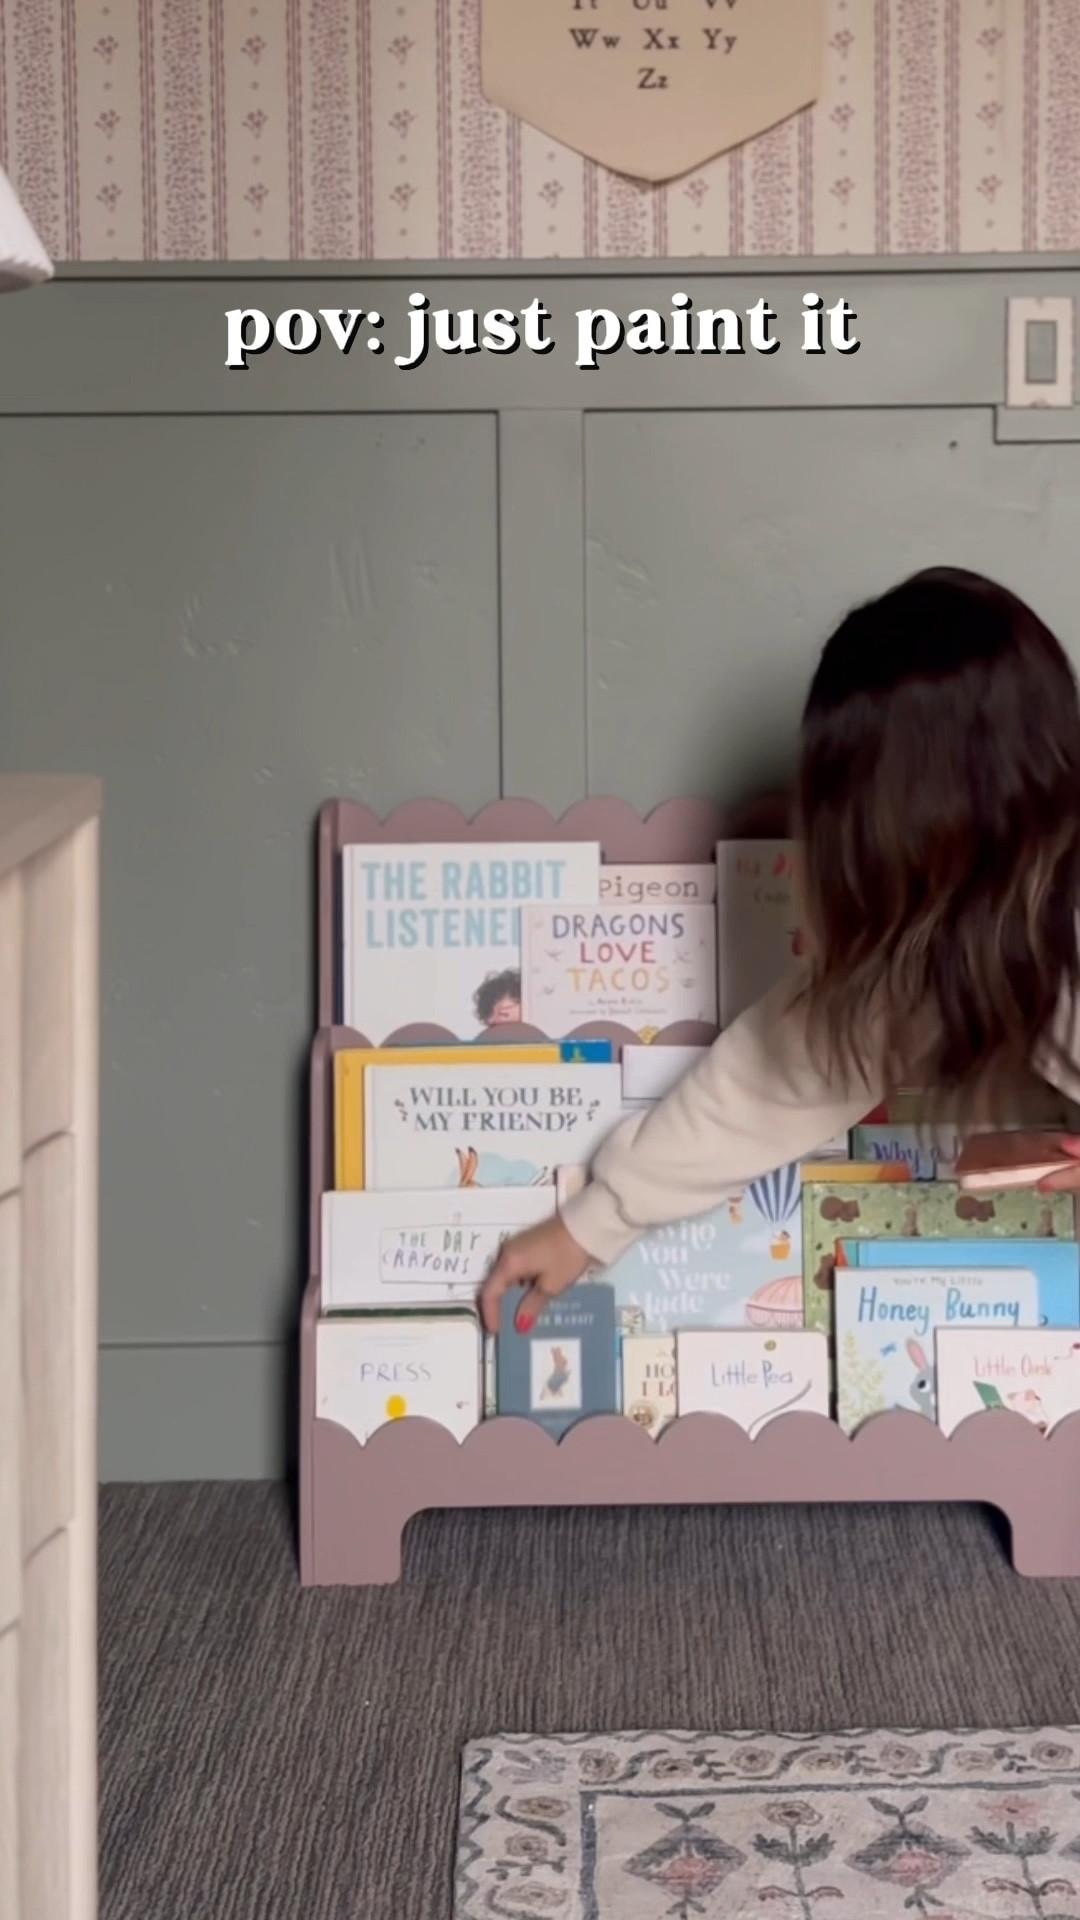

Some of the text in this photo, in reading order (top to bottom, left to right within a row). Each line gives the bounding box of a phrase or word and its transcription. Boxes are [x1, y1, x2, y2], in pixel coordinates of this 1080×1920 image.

[568, 27, 737, 54] Ww Xx Yy
[637, 67, 668, 89] Zz
[360, 860, 566, 900] THE RABBIT
[599, 875, 699, 903] Pigeon
[552, 912, 685, 939] DRAGONS
[579, 941, 657, 964] LOVE
[566, 967, 670, 993] TACOS
[409, 1087, 583, 1108] WILL YOU BE
[414, 1112, 578, 1132] MY FRIEND?
[399, 1231, 427, 1247] THE
[382, 1248, 470, 1275] CRAYONS
[857, 1286, 1020, 1336] Honey Bunny
[360, 1362, 432, 1383] PRESS
[711, 1360, 793, 1388] Little Pea
